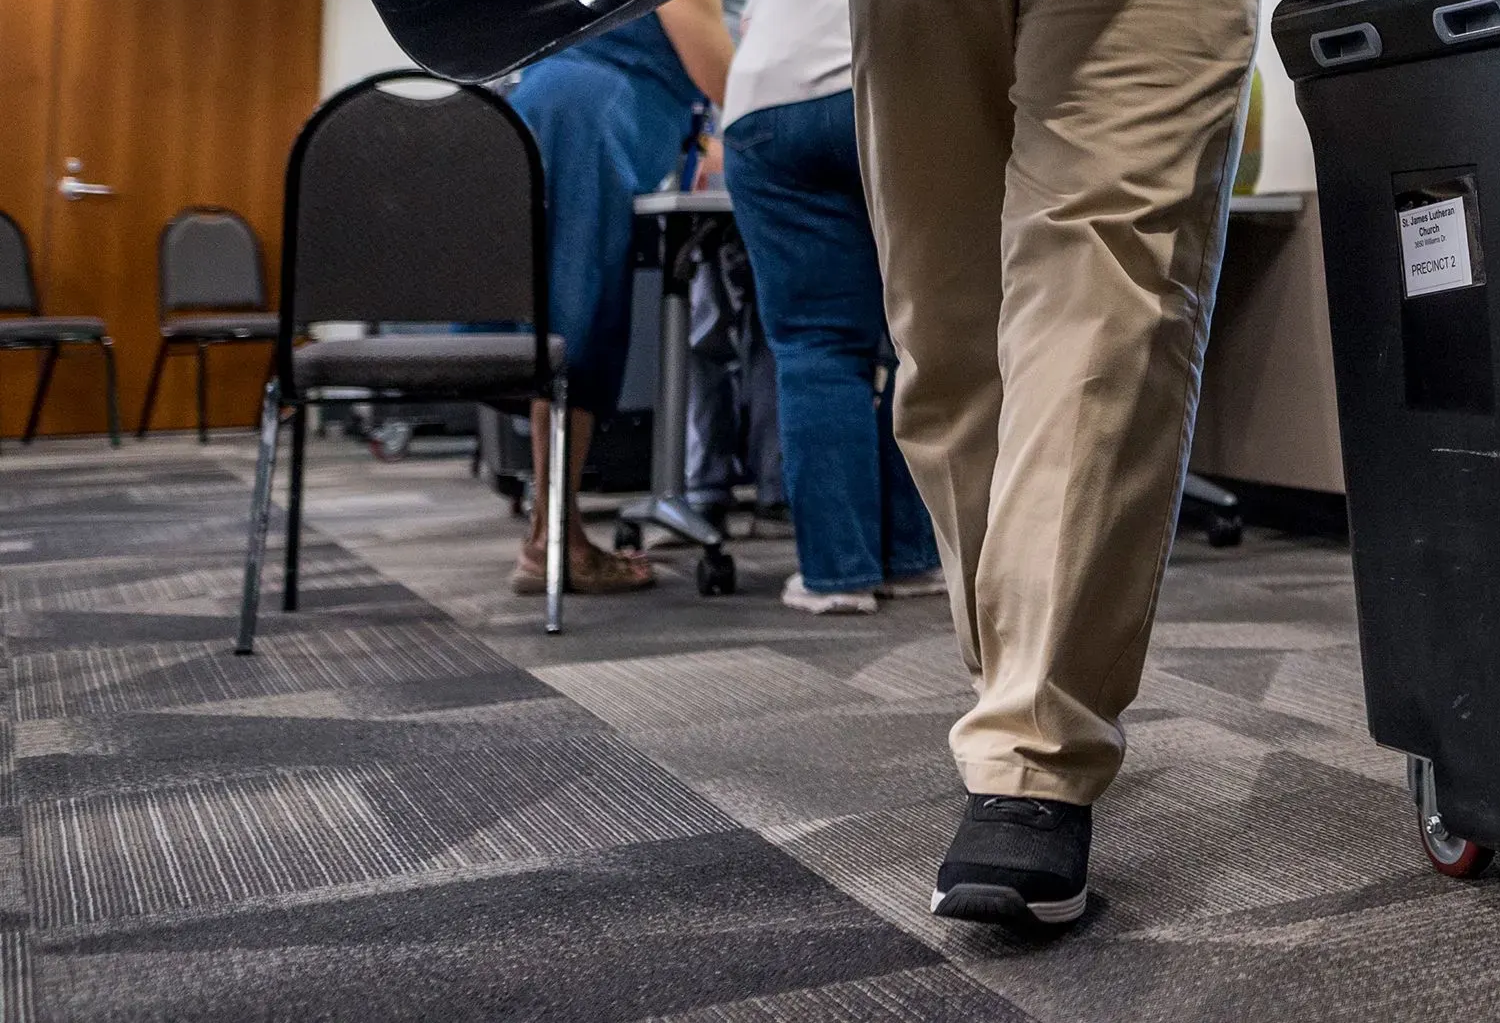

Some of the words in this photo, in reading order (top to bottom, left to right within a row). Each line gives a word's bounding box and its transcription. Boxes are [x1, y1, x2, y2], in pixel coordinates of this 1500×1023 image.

[1401, 218, 1410, 228] St.
[1410, 214, 1429, 226] James
[1429, 207, 1455, 221] Lutheran
[1418, 224, 1440, 237] Church
[1411, 256, 1449, 276] PRECINCT
[1450, 255, 1456, 268] 2
